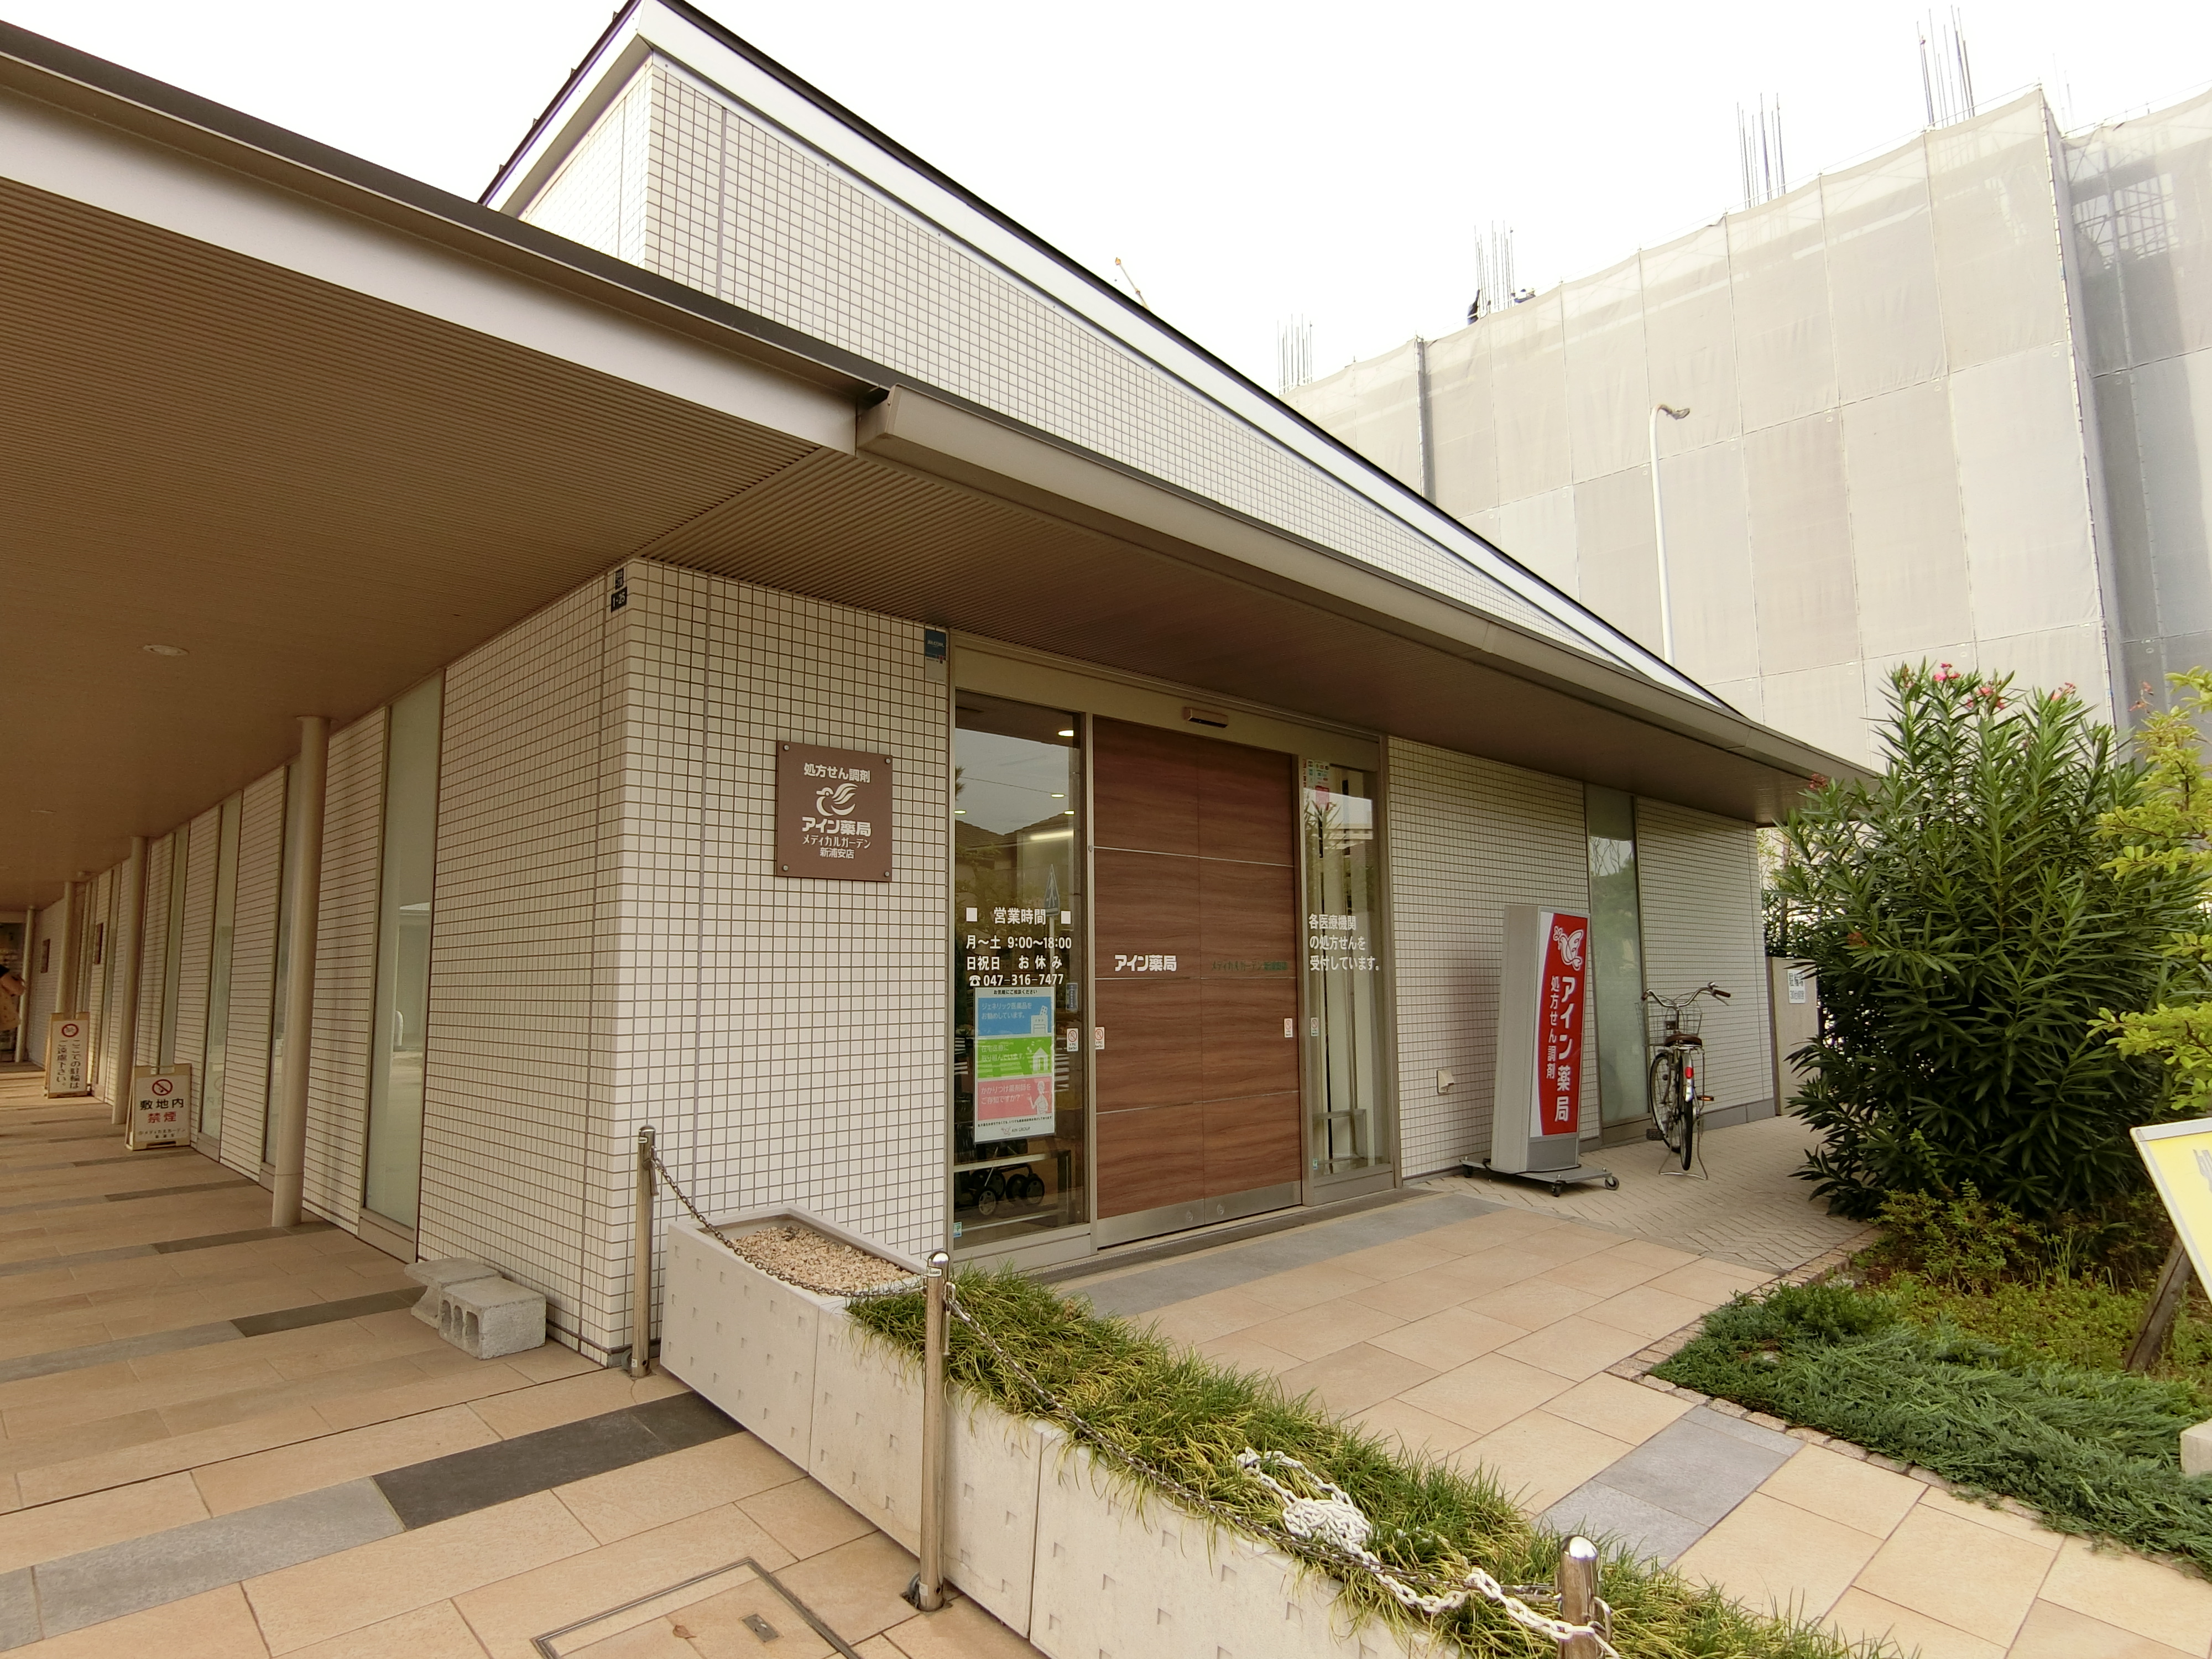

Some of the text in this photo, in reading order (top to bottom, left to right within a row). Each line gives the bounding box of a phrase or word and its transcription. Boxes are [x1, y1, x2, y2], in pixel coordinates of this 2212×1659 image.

[804, 762, 871, 783] 処方せん調剤
[802, 816, 872, 837] アイン薬局
[802, 834, 872, 849] メディカルガーデン
[820, 847, 855, 859] 新浦安店
[993, 906, 1046, 925] 営業時間
[1308, 913, 1357, 930] 各医療機関
[1310, 934, 1366, 951] の処方せんを
[967, 956, 1000, 971] 日祝日
[1114, 954, 1177, 972] アイン薬局
[1310, 954, 1379, 971] 受付しています。
[983, 973, 1064, 986] 047-316-7477
[1546, 975, 1560, 1079] 処方せん調剤
[1554, 976, 1575, 1122] アイン薬局
[140, 1098, 184, 1110] 敷地内
[148, 1111, 176, 1124] 禁煙
